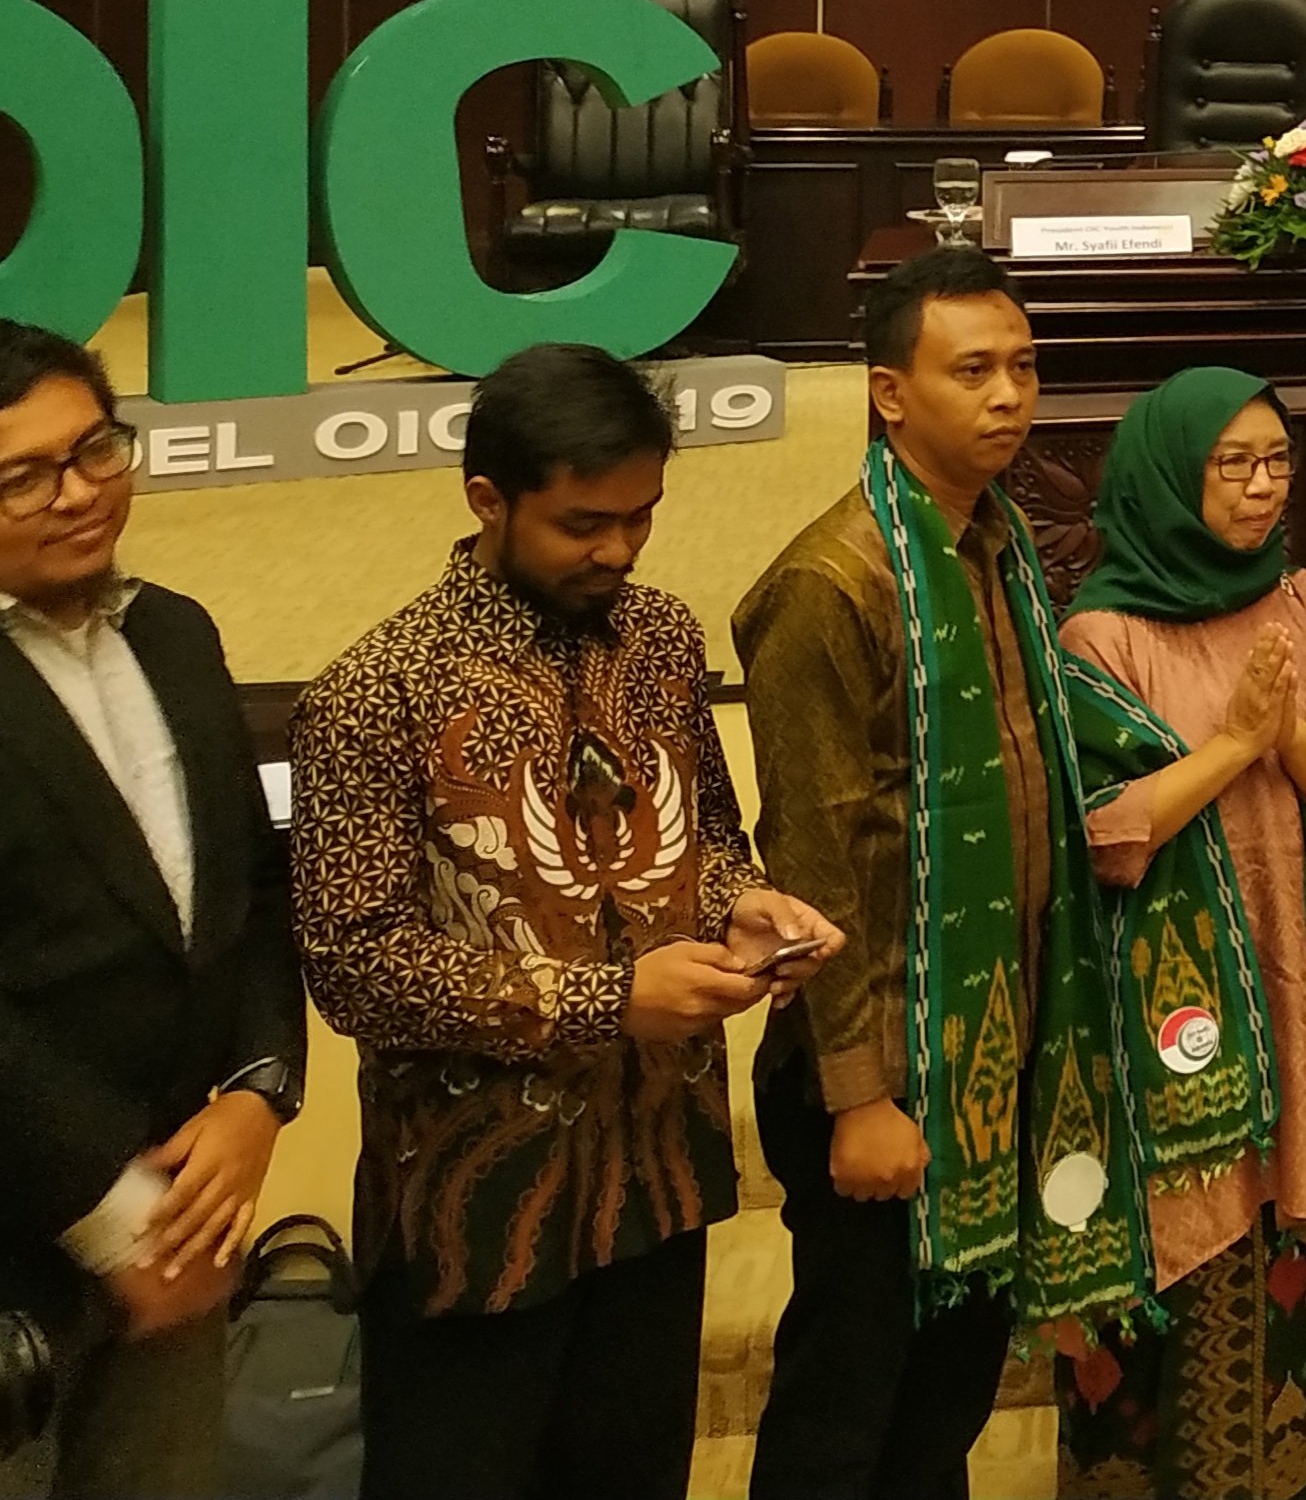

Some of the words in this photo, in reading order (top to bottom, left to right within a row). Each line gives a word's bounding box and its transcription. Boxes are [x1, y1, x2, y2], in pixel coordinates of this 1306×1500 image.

[1055, 241, 1079, 251] Mr.
[1082, 239, 1118, 252] Syafii
[1122, 238, 1162, 249] Efendi
